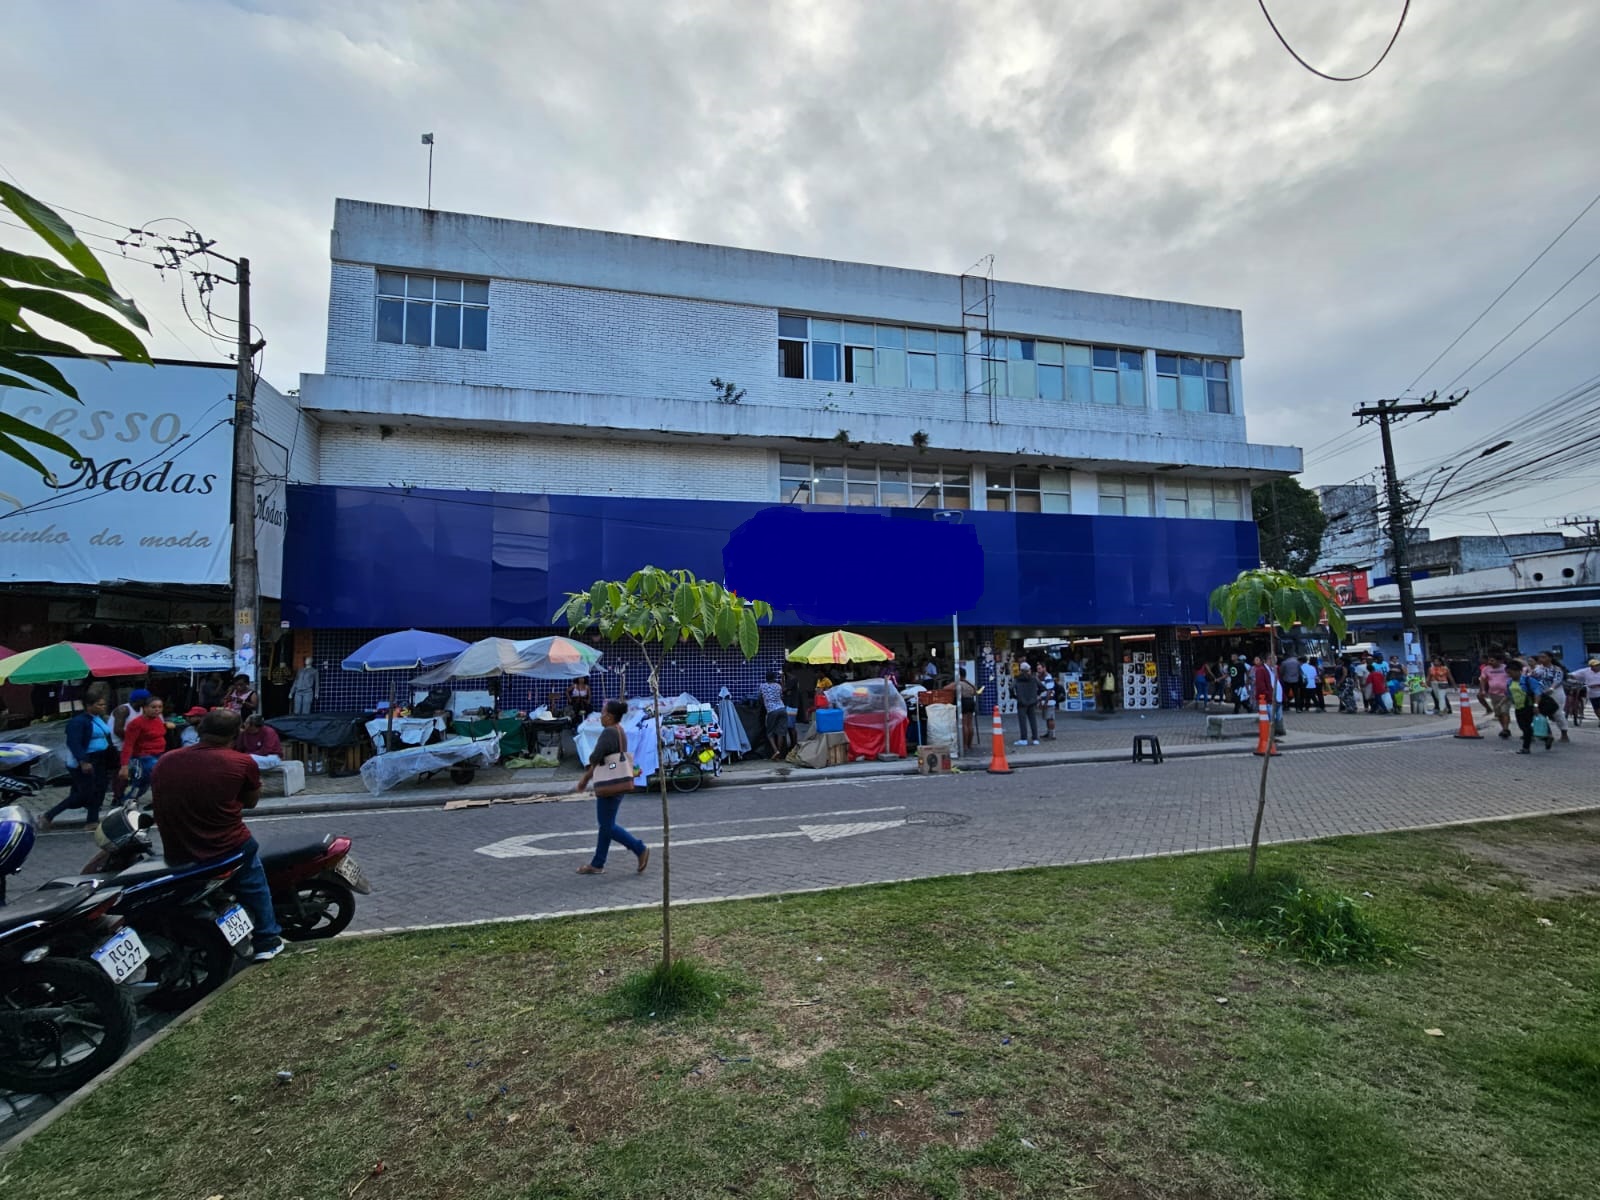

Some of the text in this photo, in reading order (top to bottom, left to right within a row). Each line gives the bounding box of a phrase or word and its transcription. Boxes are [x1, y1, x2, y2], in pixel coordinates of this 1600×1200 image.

[43, 457, 217, 495] Modas
[89, 527, 125, 546] da
[139, 530, 213, 548] moda
[225, 913, 242, 930] RCY
